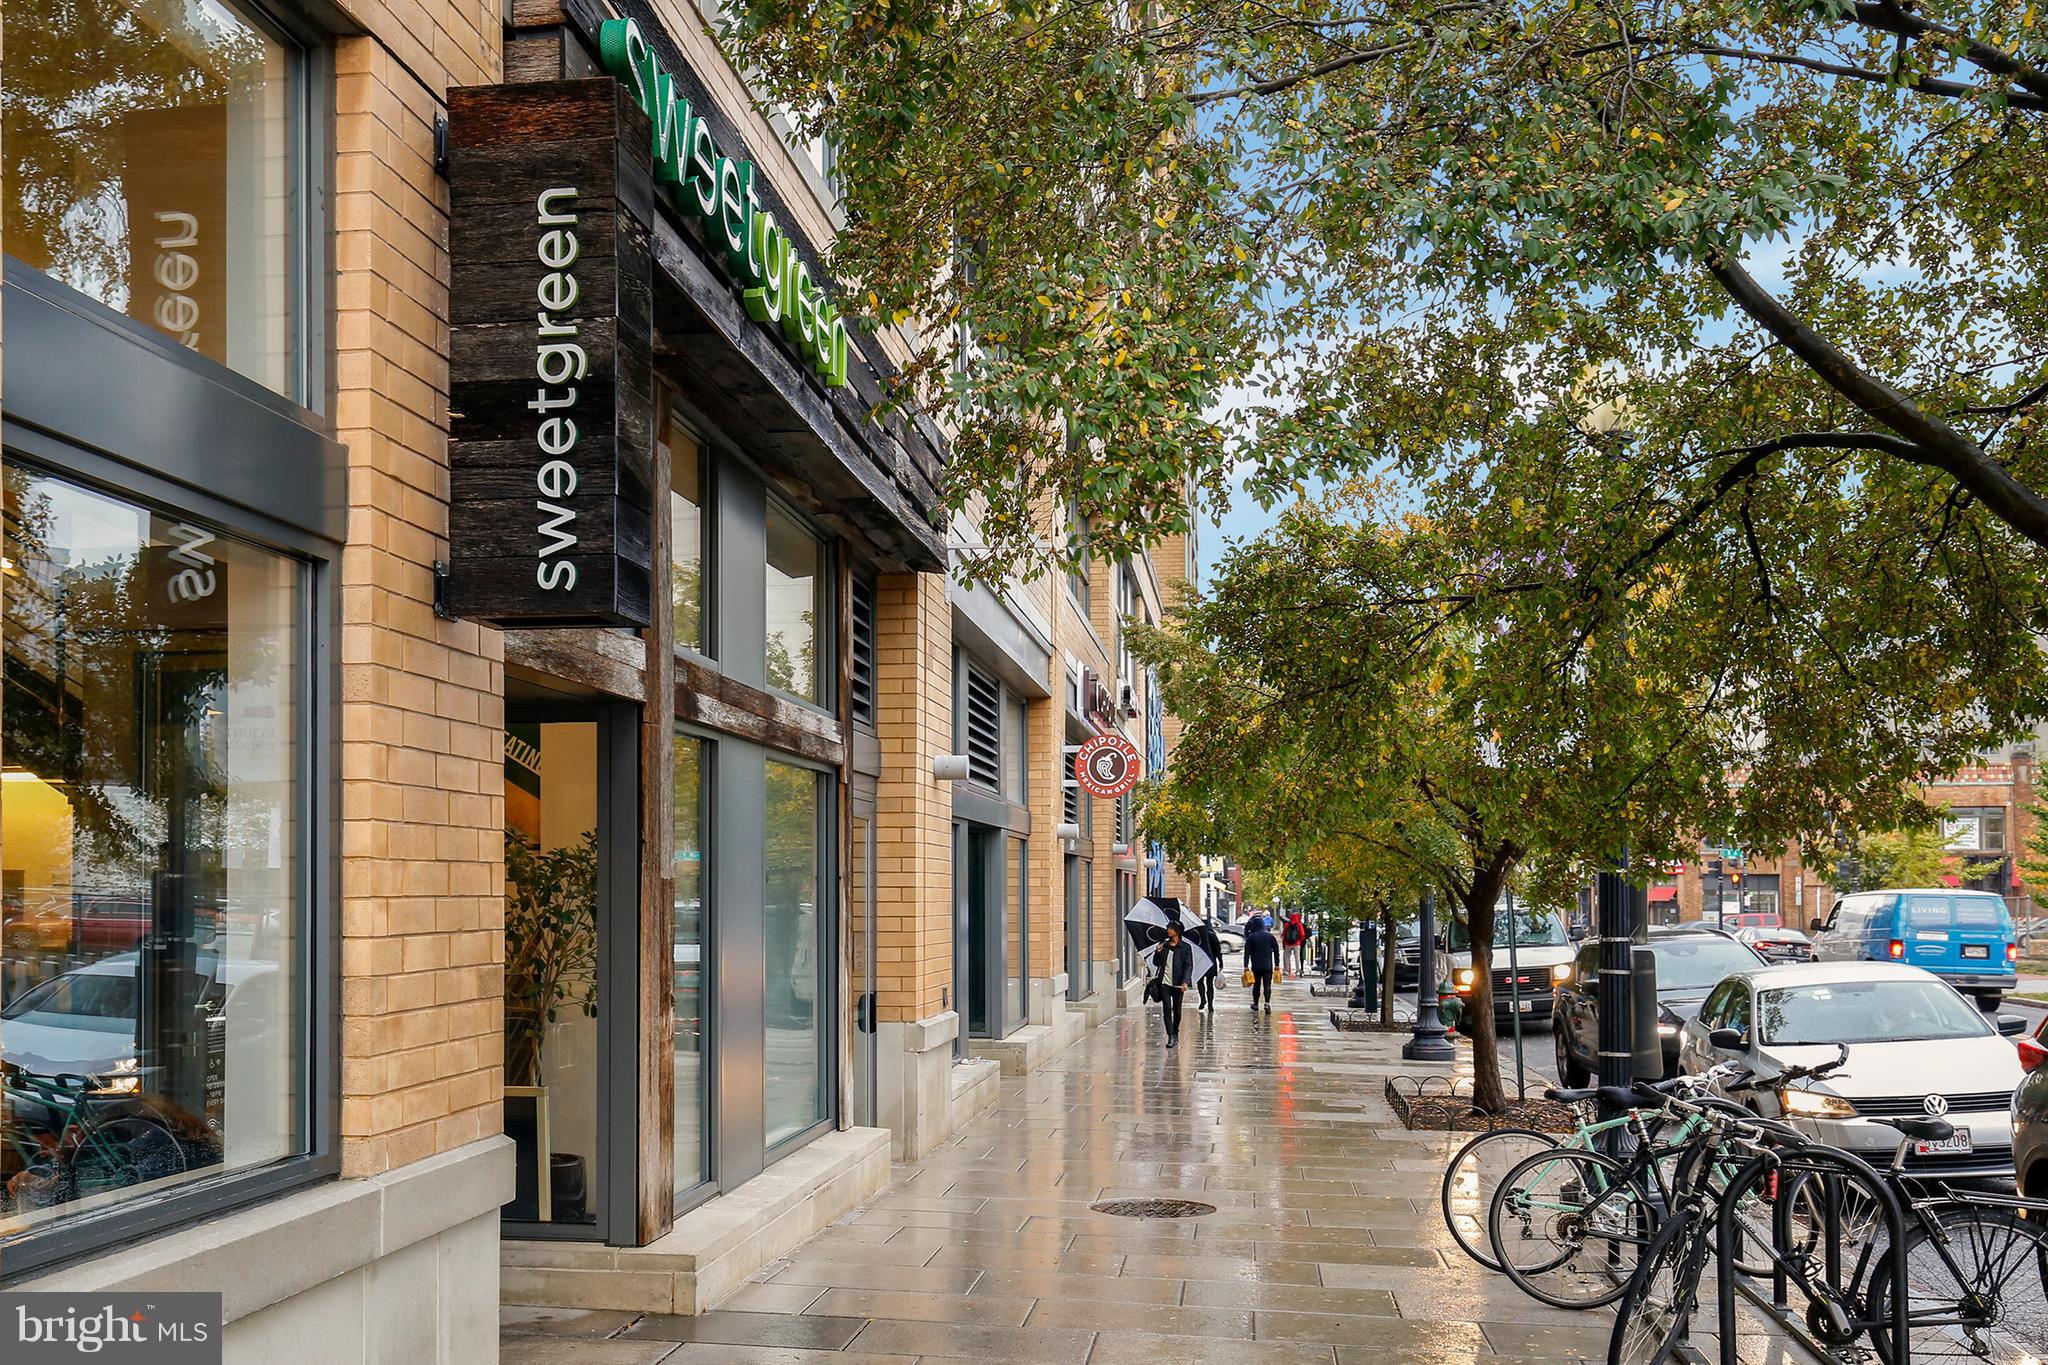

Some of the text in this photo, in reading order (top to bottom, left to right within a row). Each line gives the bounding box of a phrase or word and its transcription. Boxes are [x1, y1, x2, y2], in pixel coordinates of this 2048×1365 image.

[600, 17, 847, 388] sweetgreen
[527, 187, 588, 592] sweetgreen
[1079, 736, 1137, 763] CHIPOTLE
[1079, 771, 1135, 795] MEXICAN GRILL
[1912, 906, 1947, 915] LIVING
